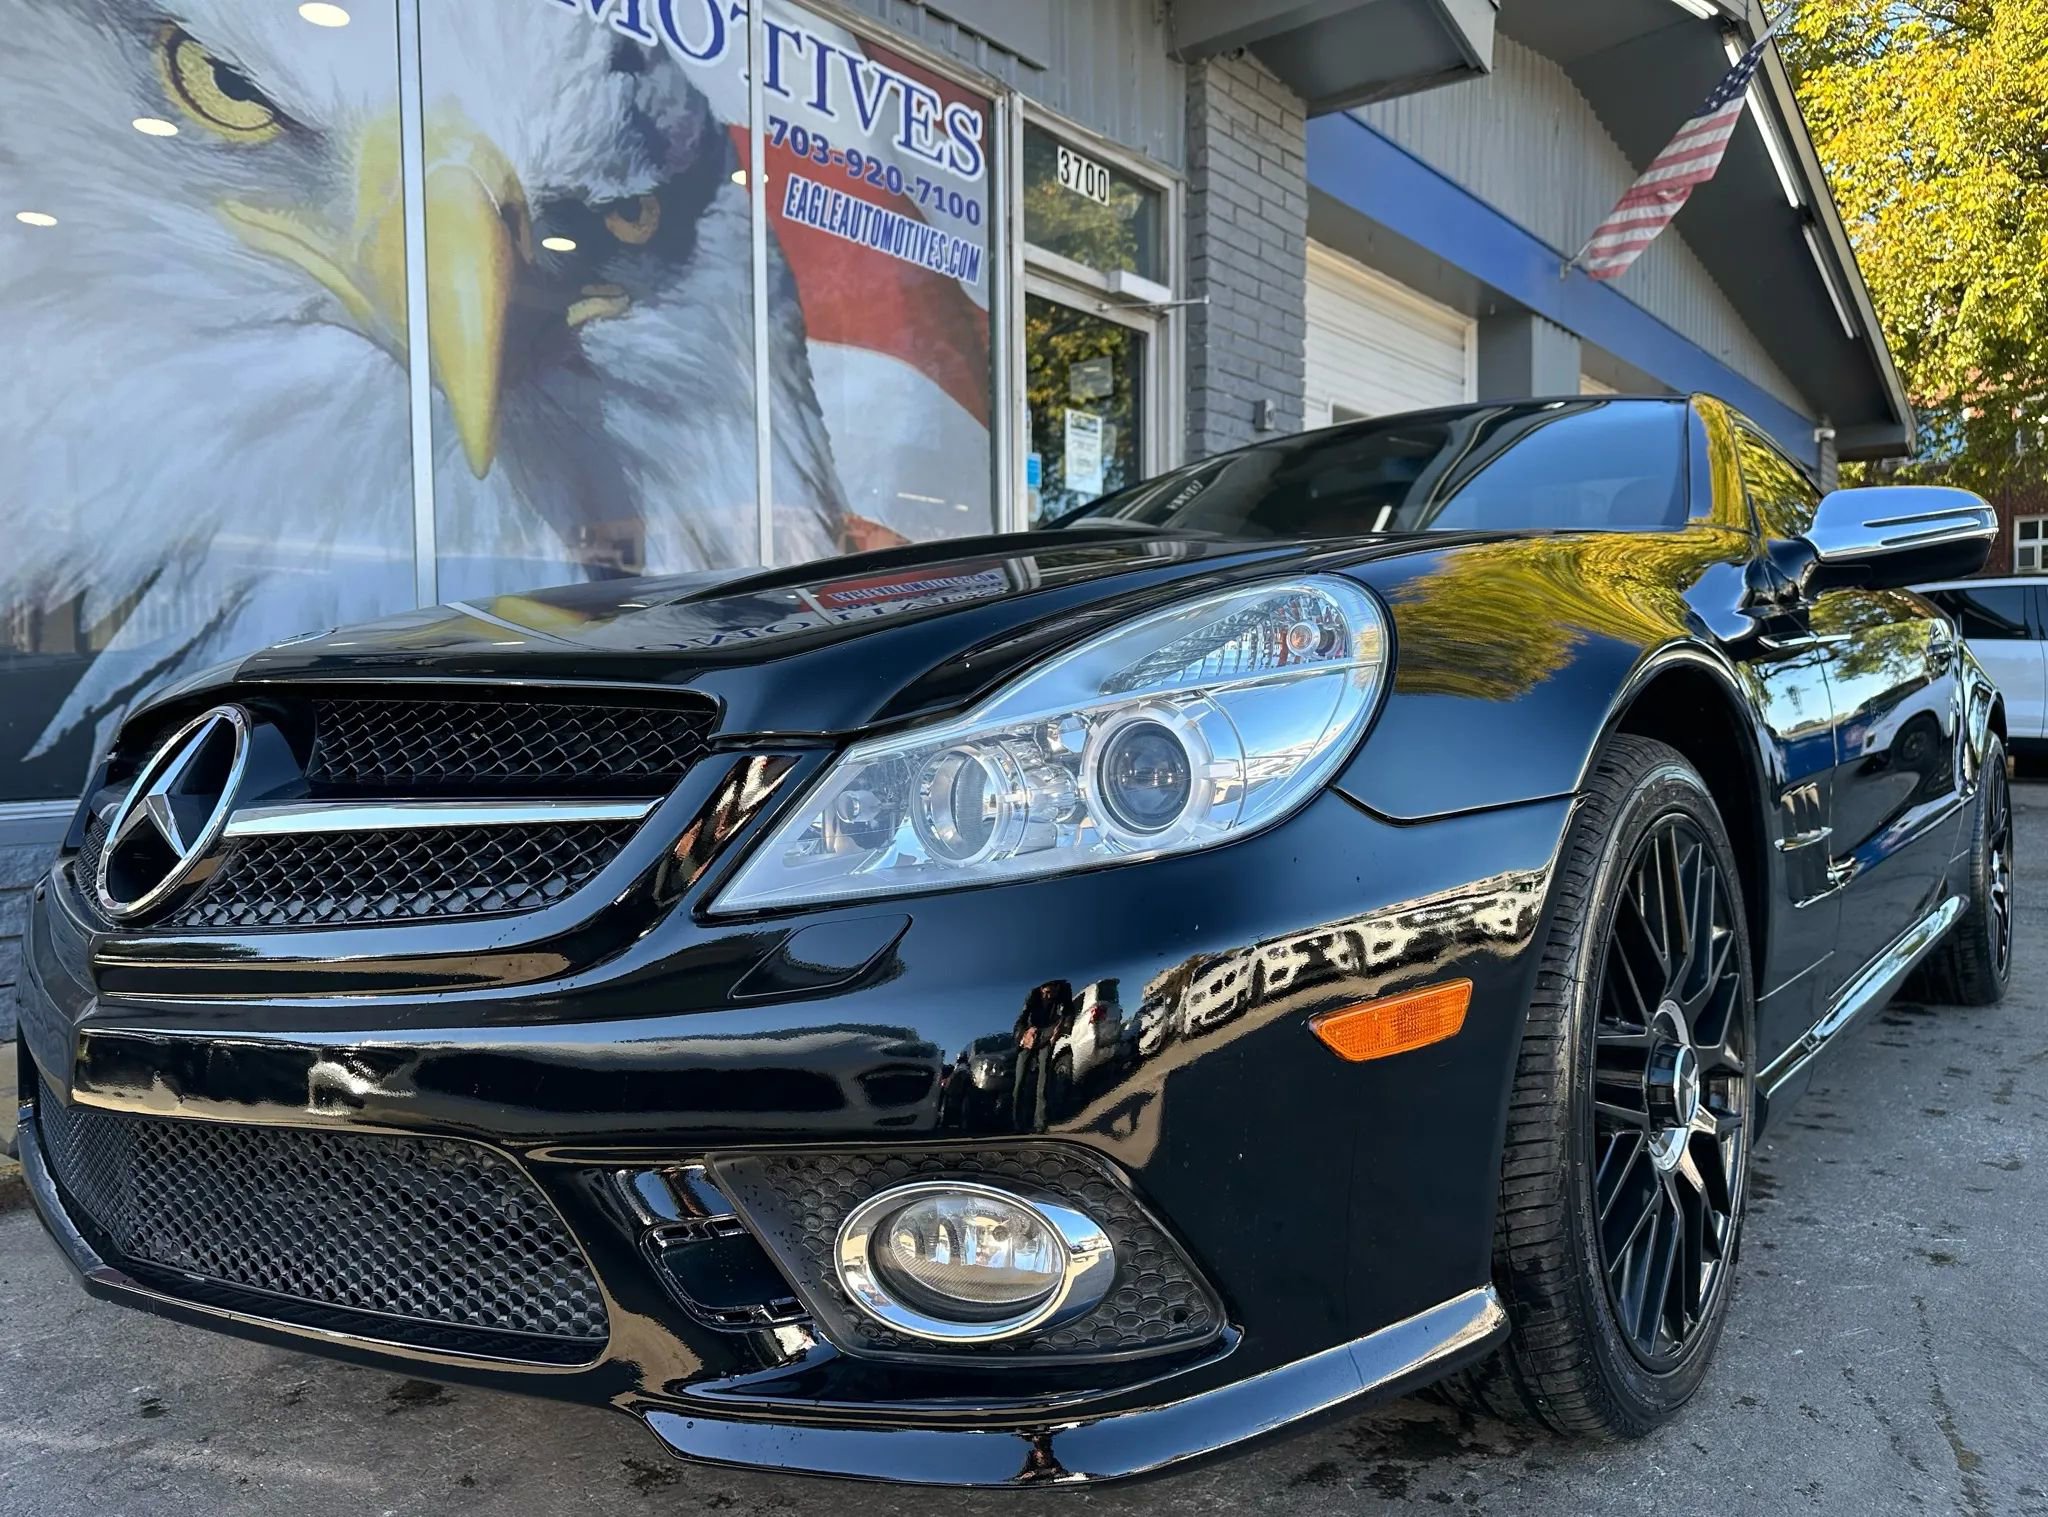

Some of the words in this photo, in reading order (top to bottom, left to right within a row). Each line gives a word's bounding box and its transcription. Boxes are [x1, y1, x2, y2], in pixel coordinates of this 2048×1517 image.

[769, 115, 981, 226] 703-920-7100
[1061, 150, 1106, 203] 3700
[784, 176, 981, 282] EAGLEAUTOMOTIVES.COM
